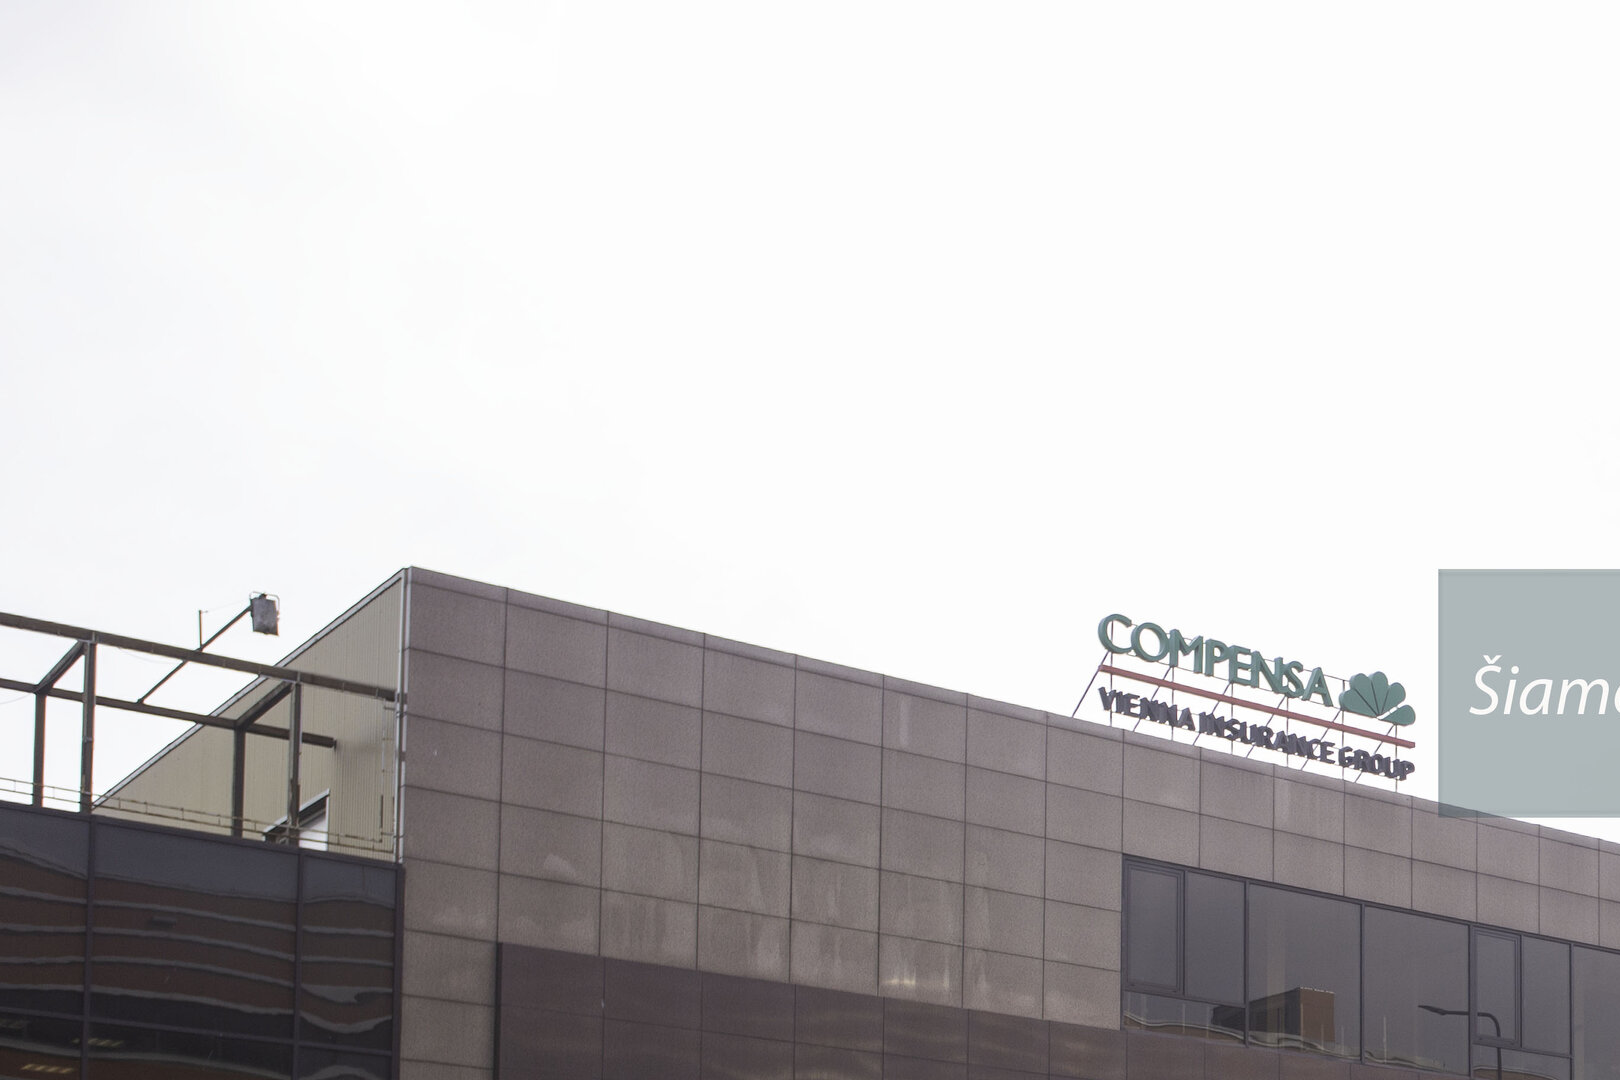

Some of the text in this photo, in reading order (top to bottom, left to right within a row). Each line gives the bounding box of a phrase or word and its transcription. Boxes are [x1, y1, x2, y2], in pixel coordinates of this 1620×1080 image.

[1098, 613, 1334, 708] COMPENSA
[1098, 686, 1415, 781] VIENNA INSURANCE GROUP
